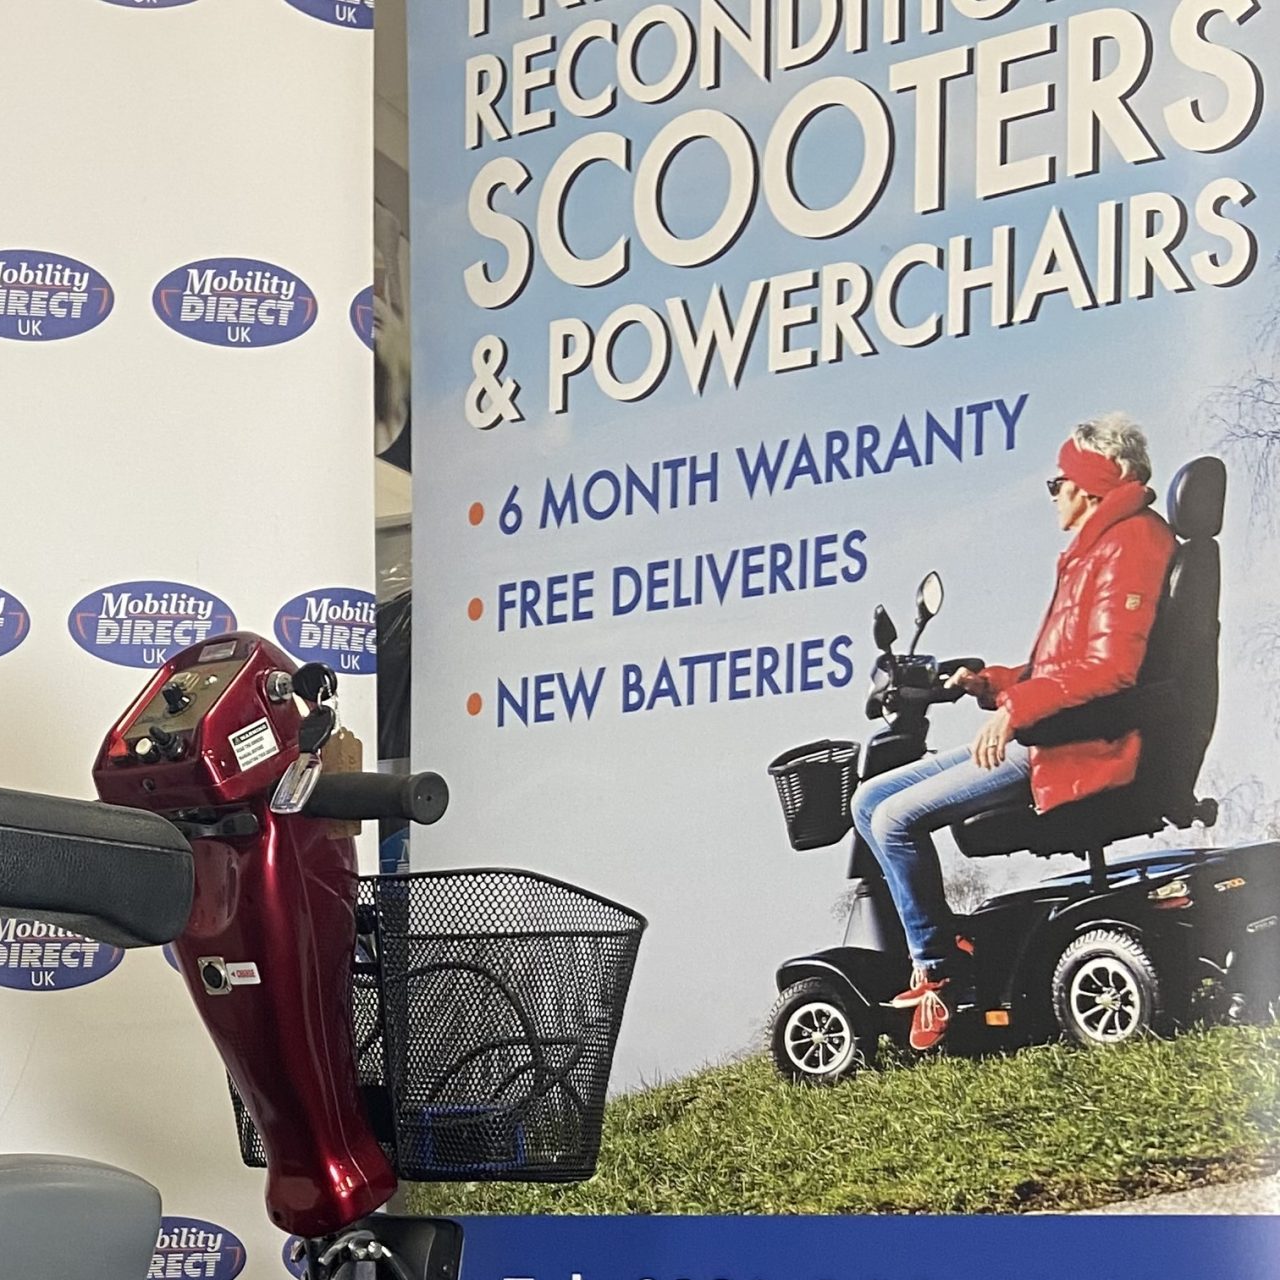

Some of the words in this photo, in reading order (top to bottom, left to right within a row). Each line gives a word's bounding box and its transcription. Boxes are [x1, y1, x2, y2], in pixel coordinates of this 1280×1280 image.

[335, 4, 358, 24] UK
[462, 0, 1264, 309] SCOOTERS
[185, 268, 296, 300] Mobility
[180, 296, 294, 326] DIRECT
[464, 335, 524, 431] &
[548, 178, 1260, 415] POWERCHAIRS
[17, 319, 42, 336] UK
[227, 325, 252, 343] UK
[498, 485, 522, 535] 6
[538, 451, 720, 530] MONTH
[735, 393, 1030, 501] WARRANTY
[497, 571, 595, 633] FREE
[612, 529, 869, 617] DELIVERIES
[98, 592, 213, 619] Mobility
[301, 597, 376, 624] Mobili
[95, 619, 212, 645] DIRECT
[142, 648, 168, 664] UK
[340, 653, 360, 670] UK
[496, 667, 606, 729] NEW
[622, 635, 854, 714] BATTERIES
[30, 971, 55, 986] UK
[155, 1226, 223, 1252] bility
[147, 1252, 221, 1279] RECT
